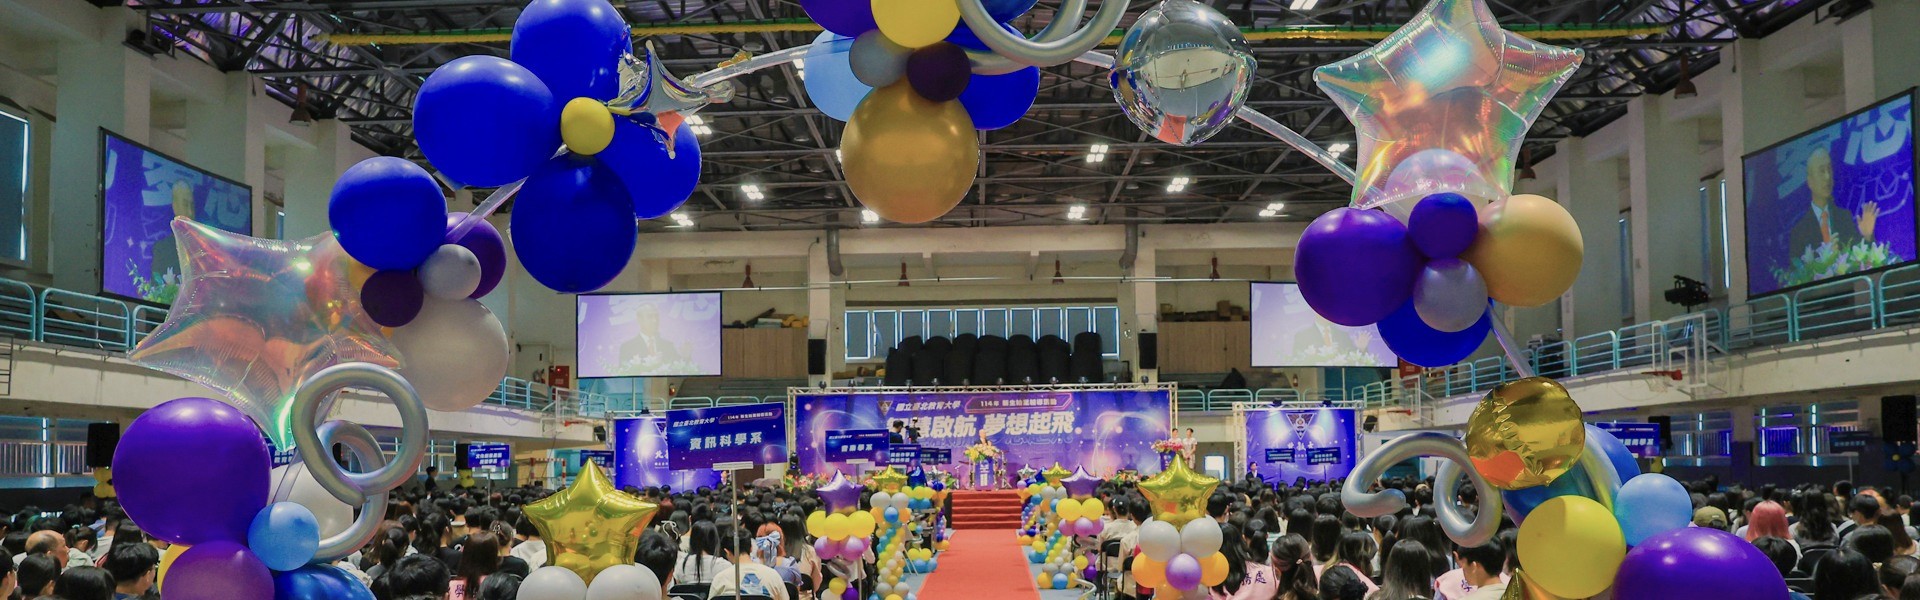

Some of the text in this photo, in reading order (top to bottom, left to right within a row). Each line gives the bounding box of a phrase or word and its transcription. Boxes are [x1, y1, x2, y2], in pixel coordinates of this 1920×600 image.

[895, 400, 962, 412] 國立臺北教育大學
[983, 410, 1075, 436] 夢想起飛
[689, 431, 763, 451] 資訊科學系
